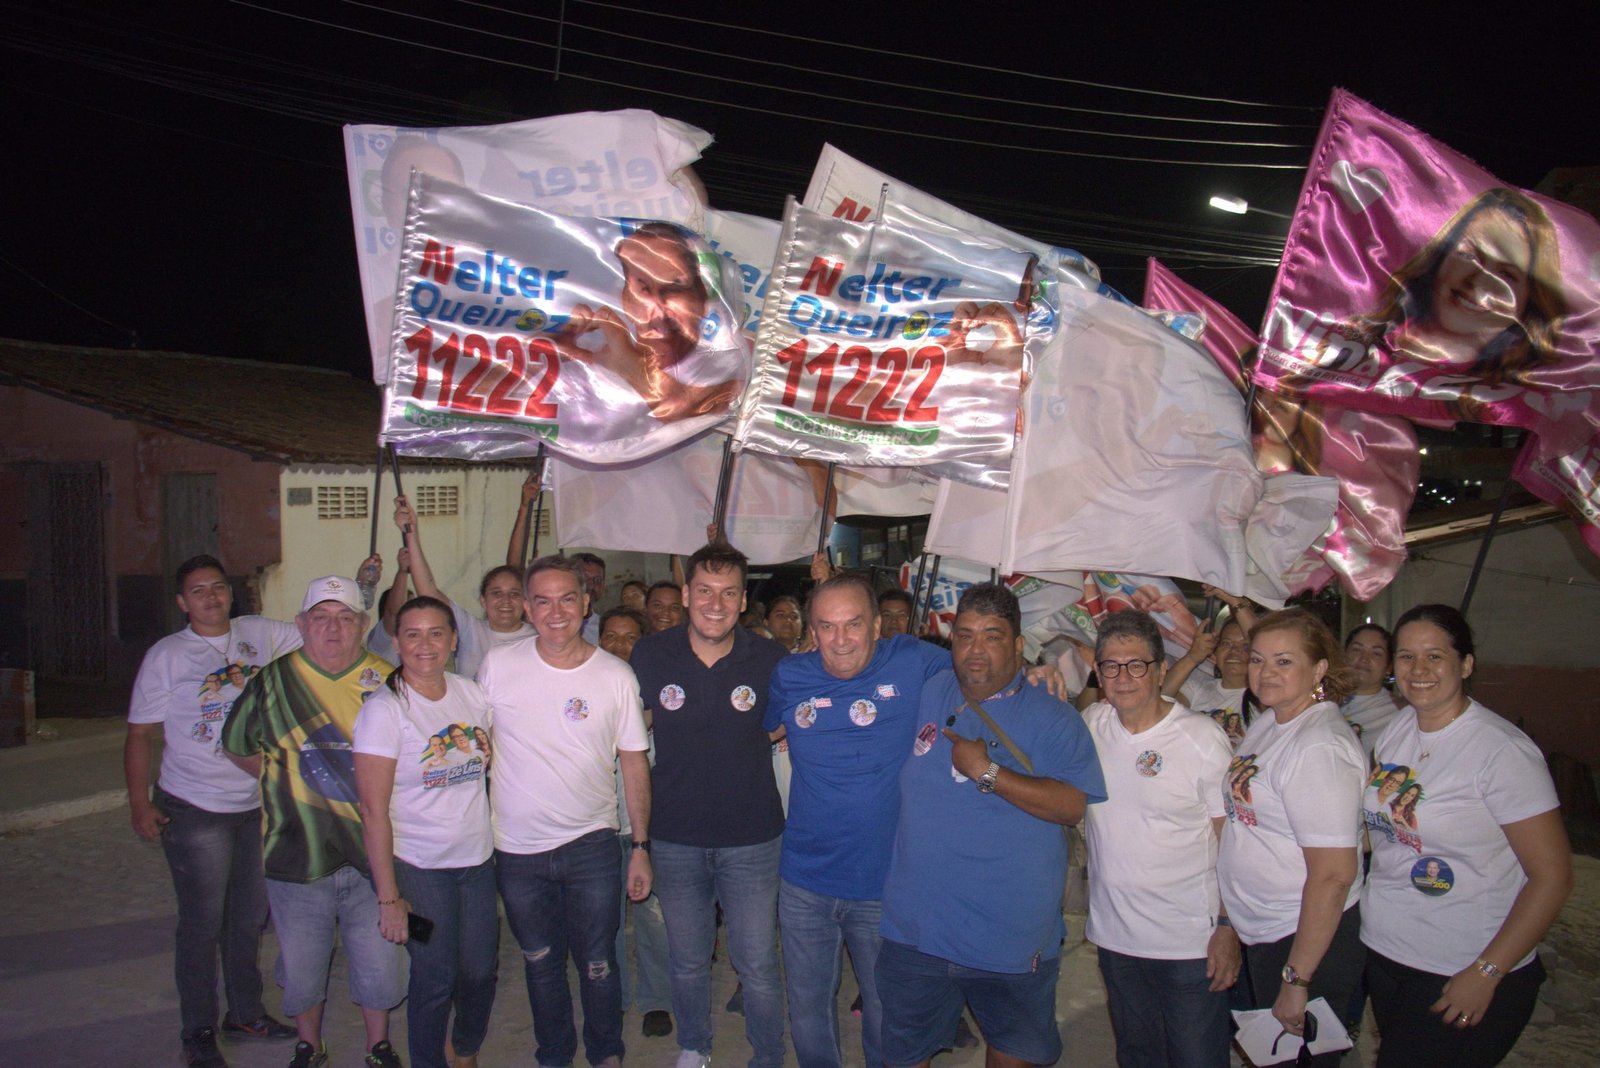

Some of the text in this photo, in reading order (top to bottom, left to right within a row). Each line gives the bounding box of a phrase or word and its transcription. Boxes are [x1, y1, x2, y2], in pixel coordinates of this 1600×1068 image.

[419, 238, 569, 301] Nelter
[800, 256, 962, 303] Nelter
[411, 280, 570, 333] Queiroz
[788, 294, 954, 340] Queiroz
[1263, 298, 1380, 377] Nina
[404, 325, 560, 419] 11222
[775, 338, 946, 422] 11222
